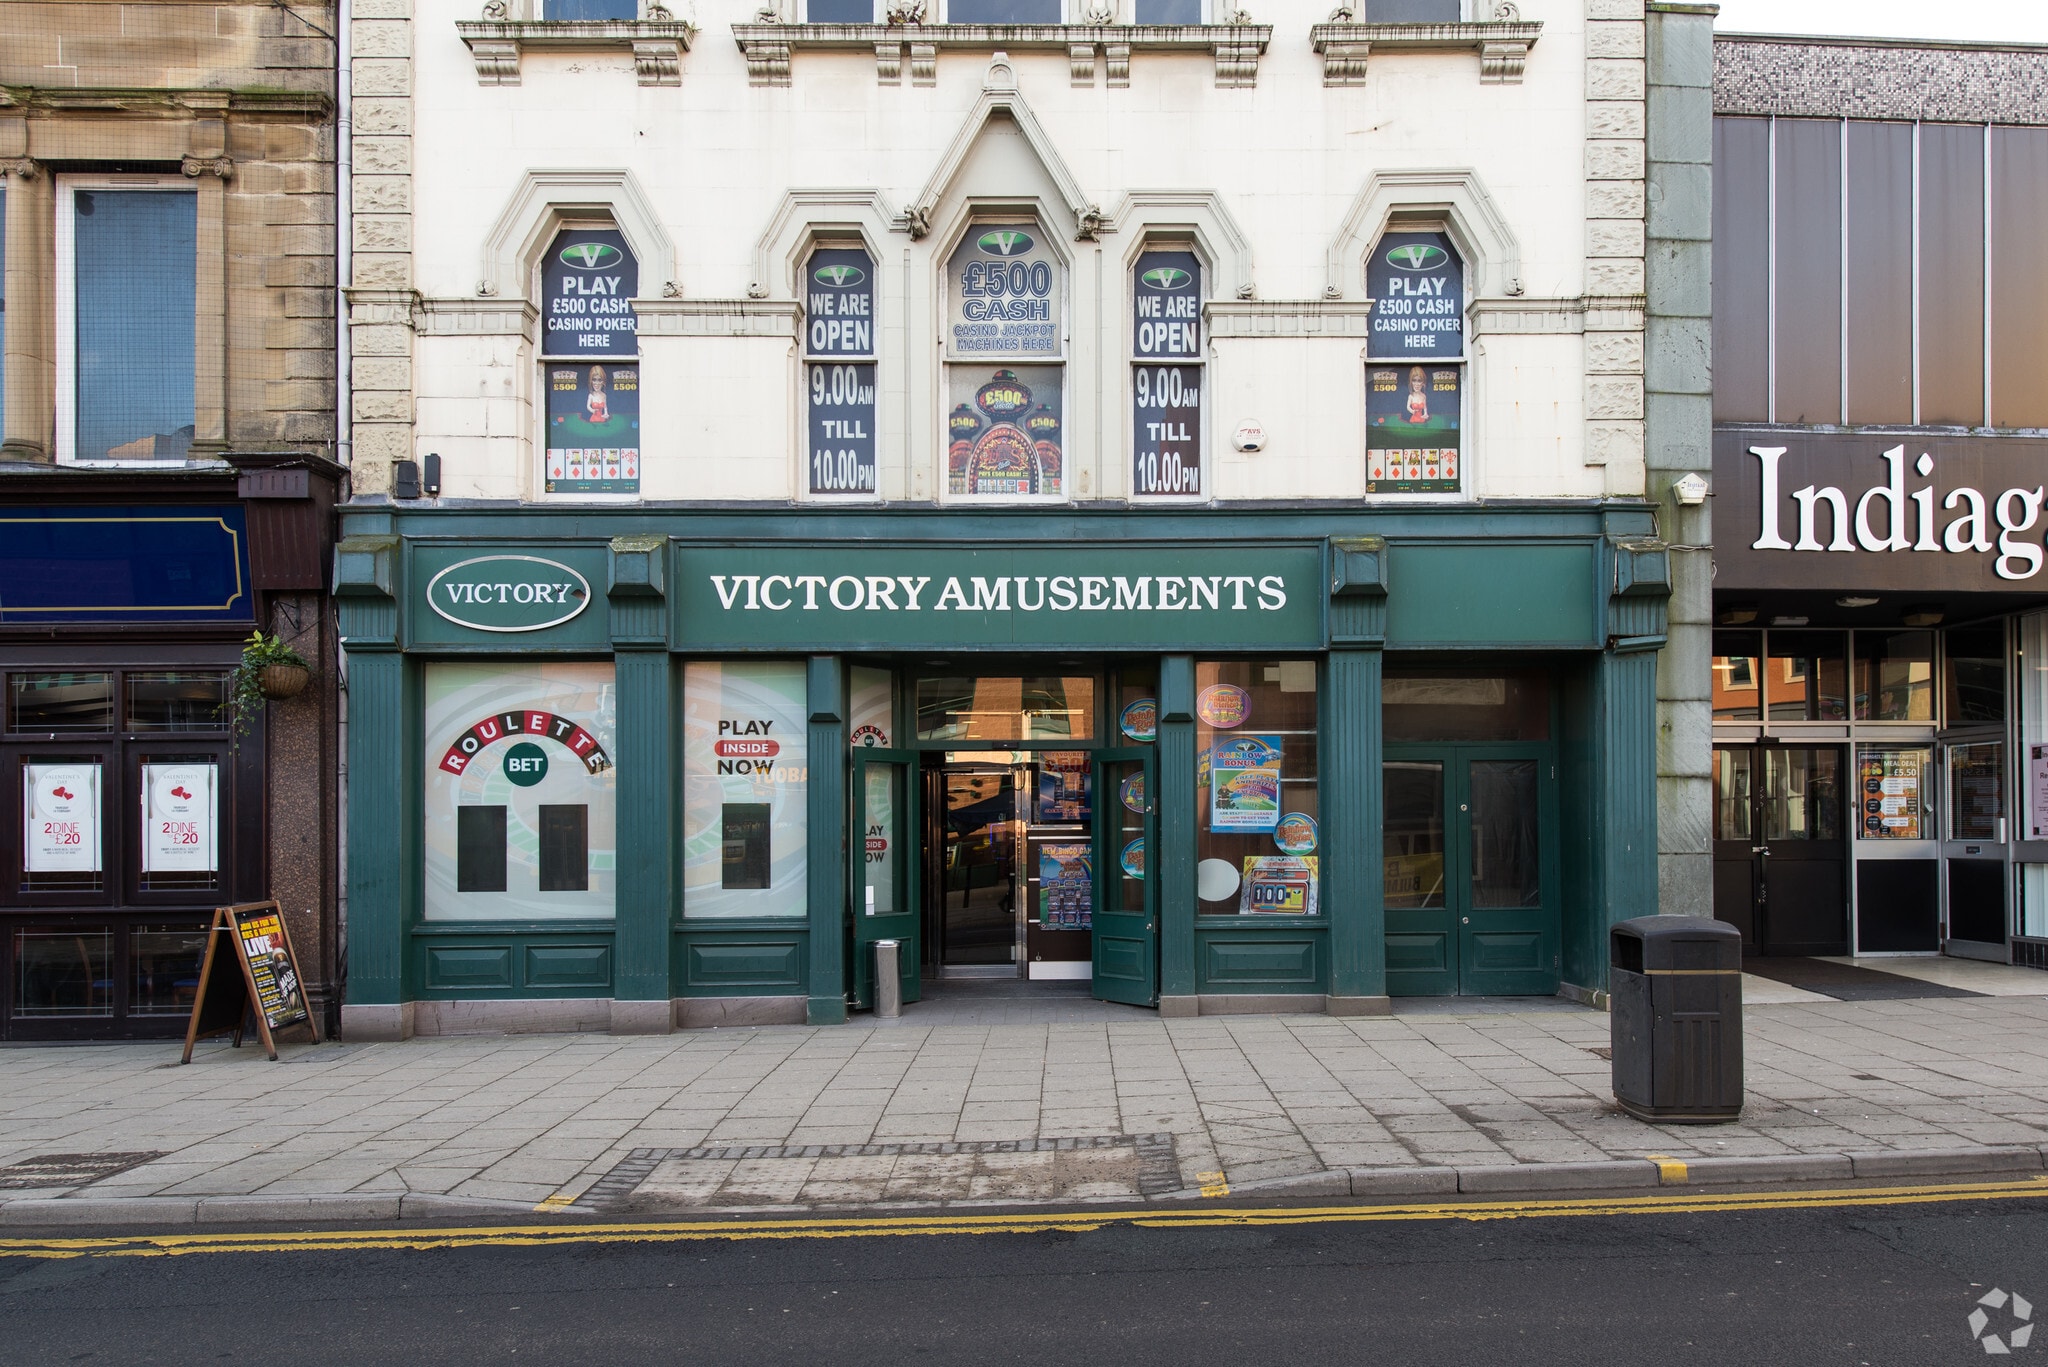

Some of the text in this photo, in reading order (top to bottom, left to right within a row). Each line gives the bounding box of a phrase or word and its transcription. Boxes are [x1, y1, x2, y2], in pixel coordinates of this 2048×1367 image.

[994, 230, 1017, 255] V
[584, 245, 603, 267] V
[1406, 247, 1427, 268] V
[830, 267, 848, 285] V
[962, 262, 1052, 298] £500
[1157, 270, 1177, 288] V
[563, 277, 621, 295] PLAY
[1389, 278, 1446, 296] PLAY
[552, 298, 629, 314] £500 CASH
[810, 294, 869, 316] WE ARE
[963, 300, 1050, 321] CASH
[1138, 296, 1196, 318] WE ARE
[1380, 300, 1454, 315] £500 CASH
[548, 318, 635, 331] CASINO POKER
[953, 324, 1056, 338] CASINO JACKPOT
[1374, 318, 1460, 332] CASINO POKER
[578, 334, 610, 347] HERE
[812, 320, 870, 350] OPEN
[1139, 322, 1196, 352] OPEN
[1404, 336, 1436, 347] HERE
[956, 338, 1054, 351] MACHINES HERE
[986, 390, 1022, 406] £500
[822, 420, 866, 438] TILL
[951, 418, 975, 427] £500
[1031, 418, 1056, 427] £500
[1147, 422, 1191, 441] TILL
[1748, 444, 2048, 580] Indiag
[446, 583, 572, 604] VICTORY
[710, 576, 1287, 611] VICTORY AMUSEMENTS
[718, 720, 774, 735] PLAY
[852, 726, 888, 744] ROULETTE
[447, 714, 604, 770] ROULETTE
[724, 744, 769, 753] INSIDE
[509, 758, 544, 772] BET
[718, 760, 774, 775] NOW
[55, 832, 80, 844] £20
[174, 833, 198, 844] £20
[244, 935, 273, 957] LIVE
